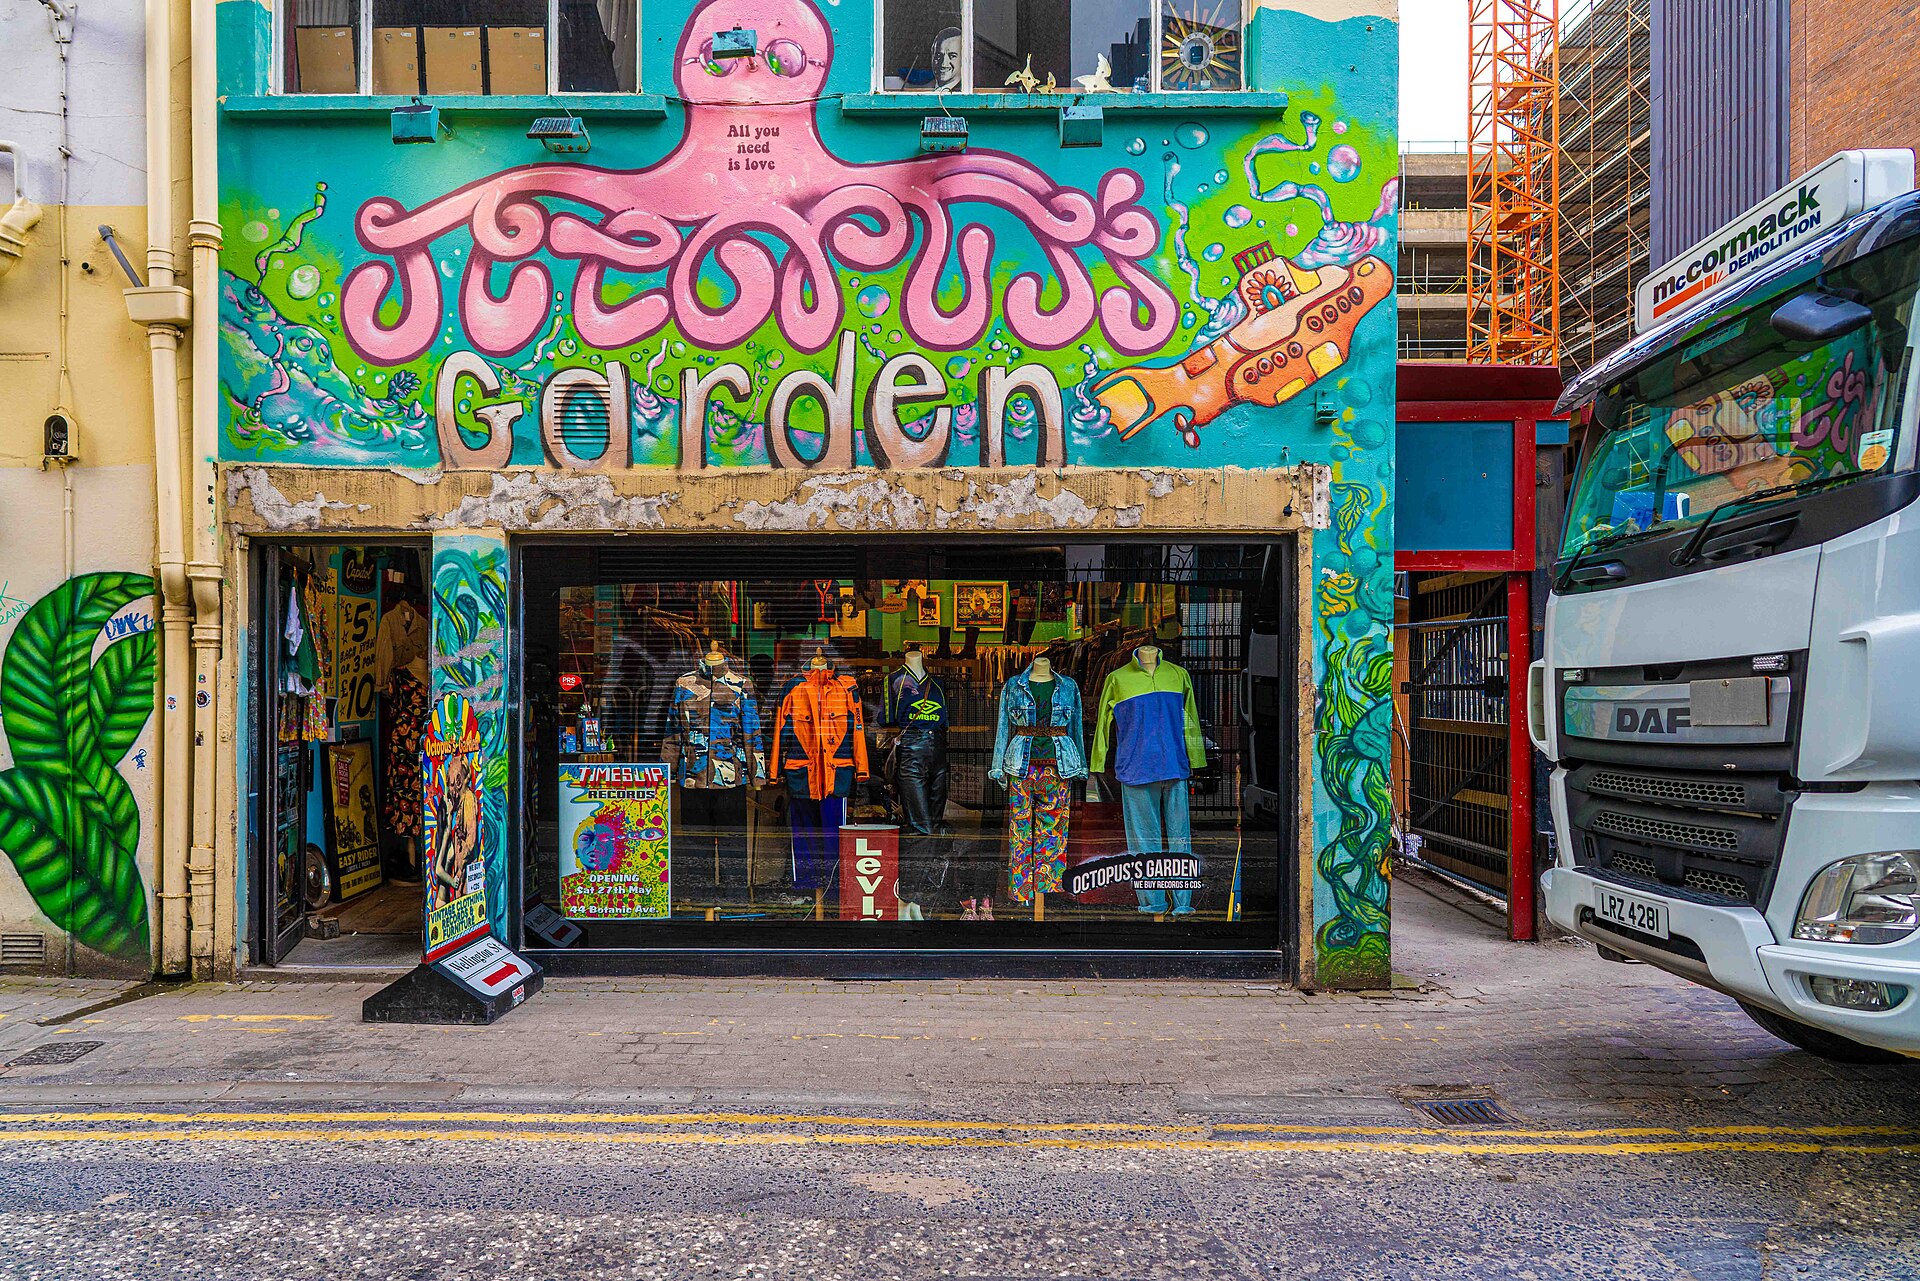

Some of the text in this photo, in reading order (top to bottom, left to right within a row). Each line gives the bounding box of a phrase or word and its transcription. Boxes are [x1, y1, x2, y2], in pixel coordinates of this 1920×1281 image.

[727, 124, 780, 140] All you
[737, 141, 770, 154] need
[728, 157, 776, 171] is love
[1728, 211, 1821, 275] DEMOLITION
[437, 329, 1067, 469] Garden
[340, 663, 350, 675] OR
[352, 654, 361, 674] 3
[340, 673, 375, 720] £10
[1616, 707, 1692, 734] DAF
[579, 767, 664, 788] TIMESLIP
[588, 790, 656, 799] RECORDS
[338, 852, 356, 869] EASY
[357, 847, 378, 863] RIDER
[589, 874, 640, 883] OPENING
[1072, 858, 1198, 894] OCTOPUS'S GARDEN
[1133, 880, 1144, 888] WE
[1144, 880, 1156, 888] BUY
[1156, 880, 1184, 888] RECORDS
[1184, 880, 1189, 888] &
[576, 885, 653, 896] Sat 27th May
[431, 904, 457, 924] VINTAGE
[441, 908, 469, 930] RECORDS
[569, 905, 659, 914] 44 Botanic Ave.
[1601, 892, 1660, 933] LRZ 4281
[442, 917, 475, 939] FURNITURE
[448, 948, 495, 973] Wellington
